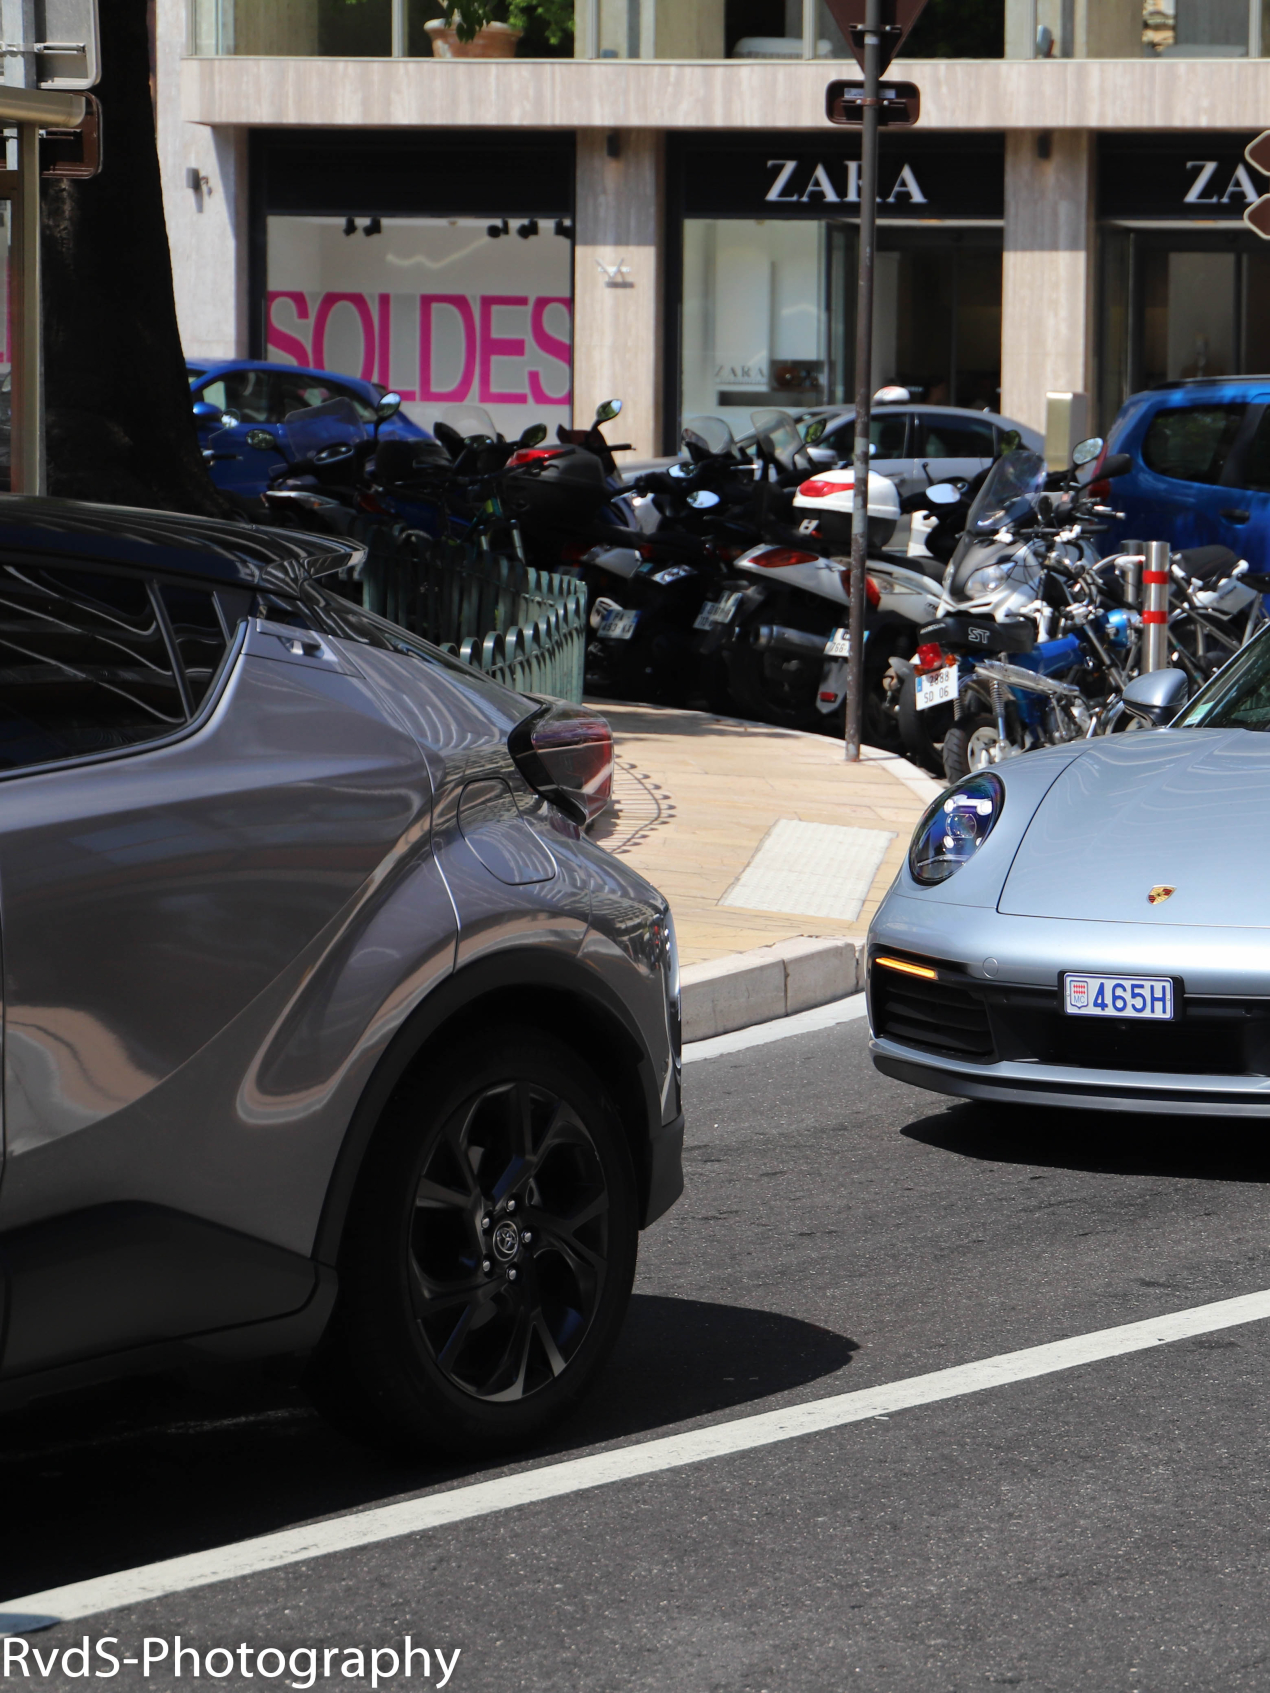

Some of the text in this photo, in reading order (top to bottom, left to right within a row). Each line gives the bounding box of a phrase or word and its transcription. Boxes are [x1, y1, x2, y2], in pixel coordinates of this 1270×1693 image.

[764, 160, 929, 203] ZARA
[267, 290, 571, 405] SOLDES
[714, 364, 767, 378] ZARA
[967, 626, 991, 644] ST
[923, 686, 949, 703] SD 06
[1073, 995, 1085, 1004] MC
[1093, 981, 1167, 1014] 465H
